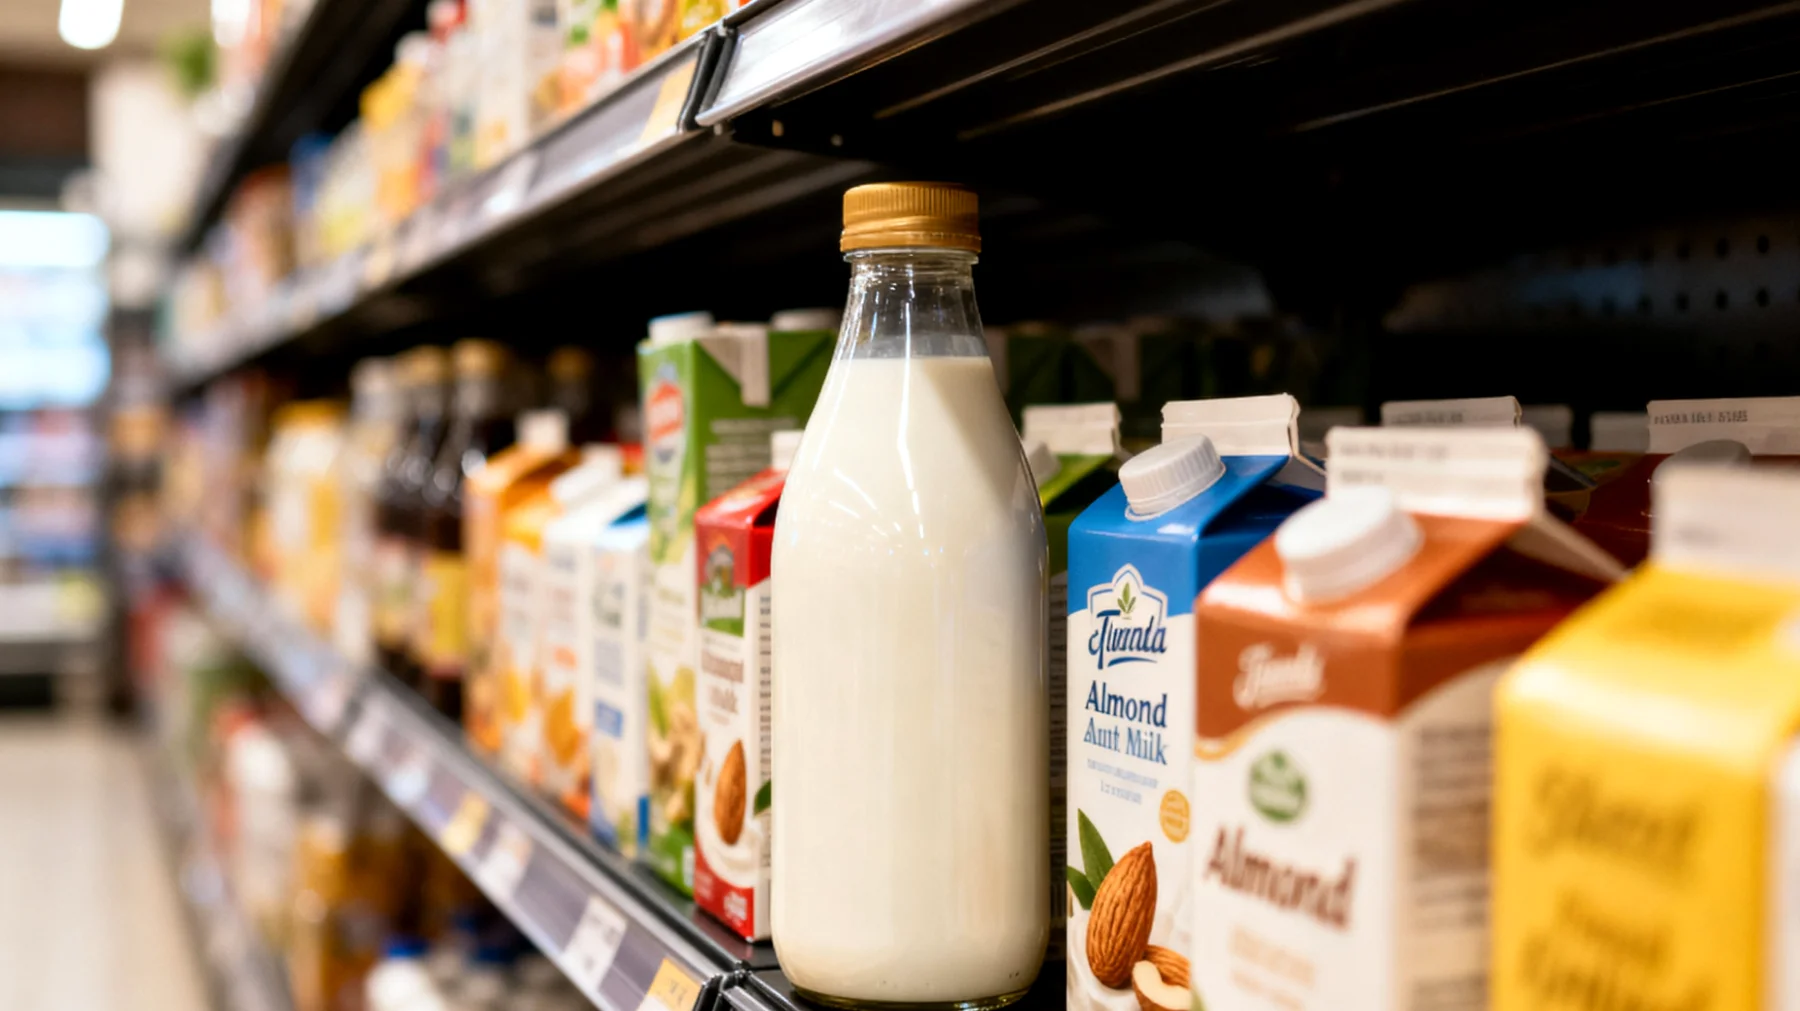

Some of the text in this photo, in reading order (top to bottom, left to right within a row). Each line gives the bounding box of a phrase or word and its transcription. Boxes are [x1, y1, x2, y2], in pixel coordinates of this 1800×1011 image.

[1085, 680, 1168, 728] Almond
[1125, 727, 1169, 765] Milk
[1204, 824, 1356, 931] Almond
